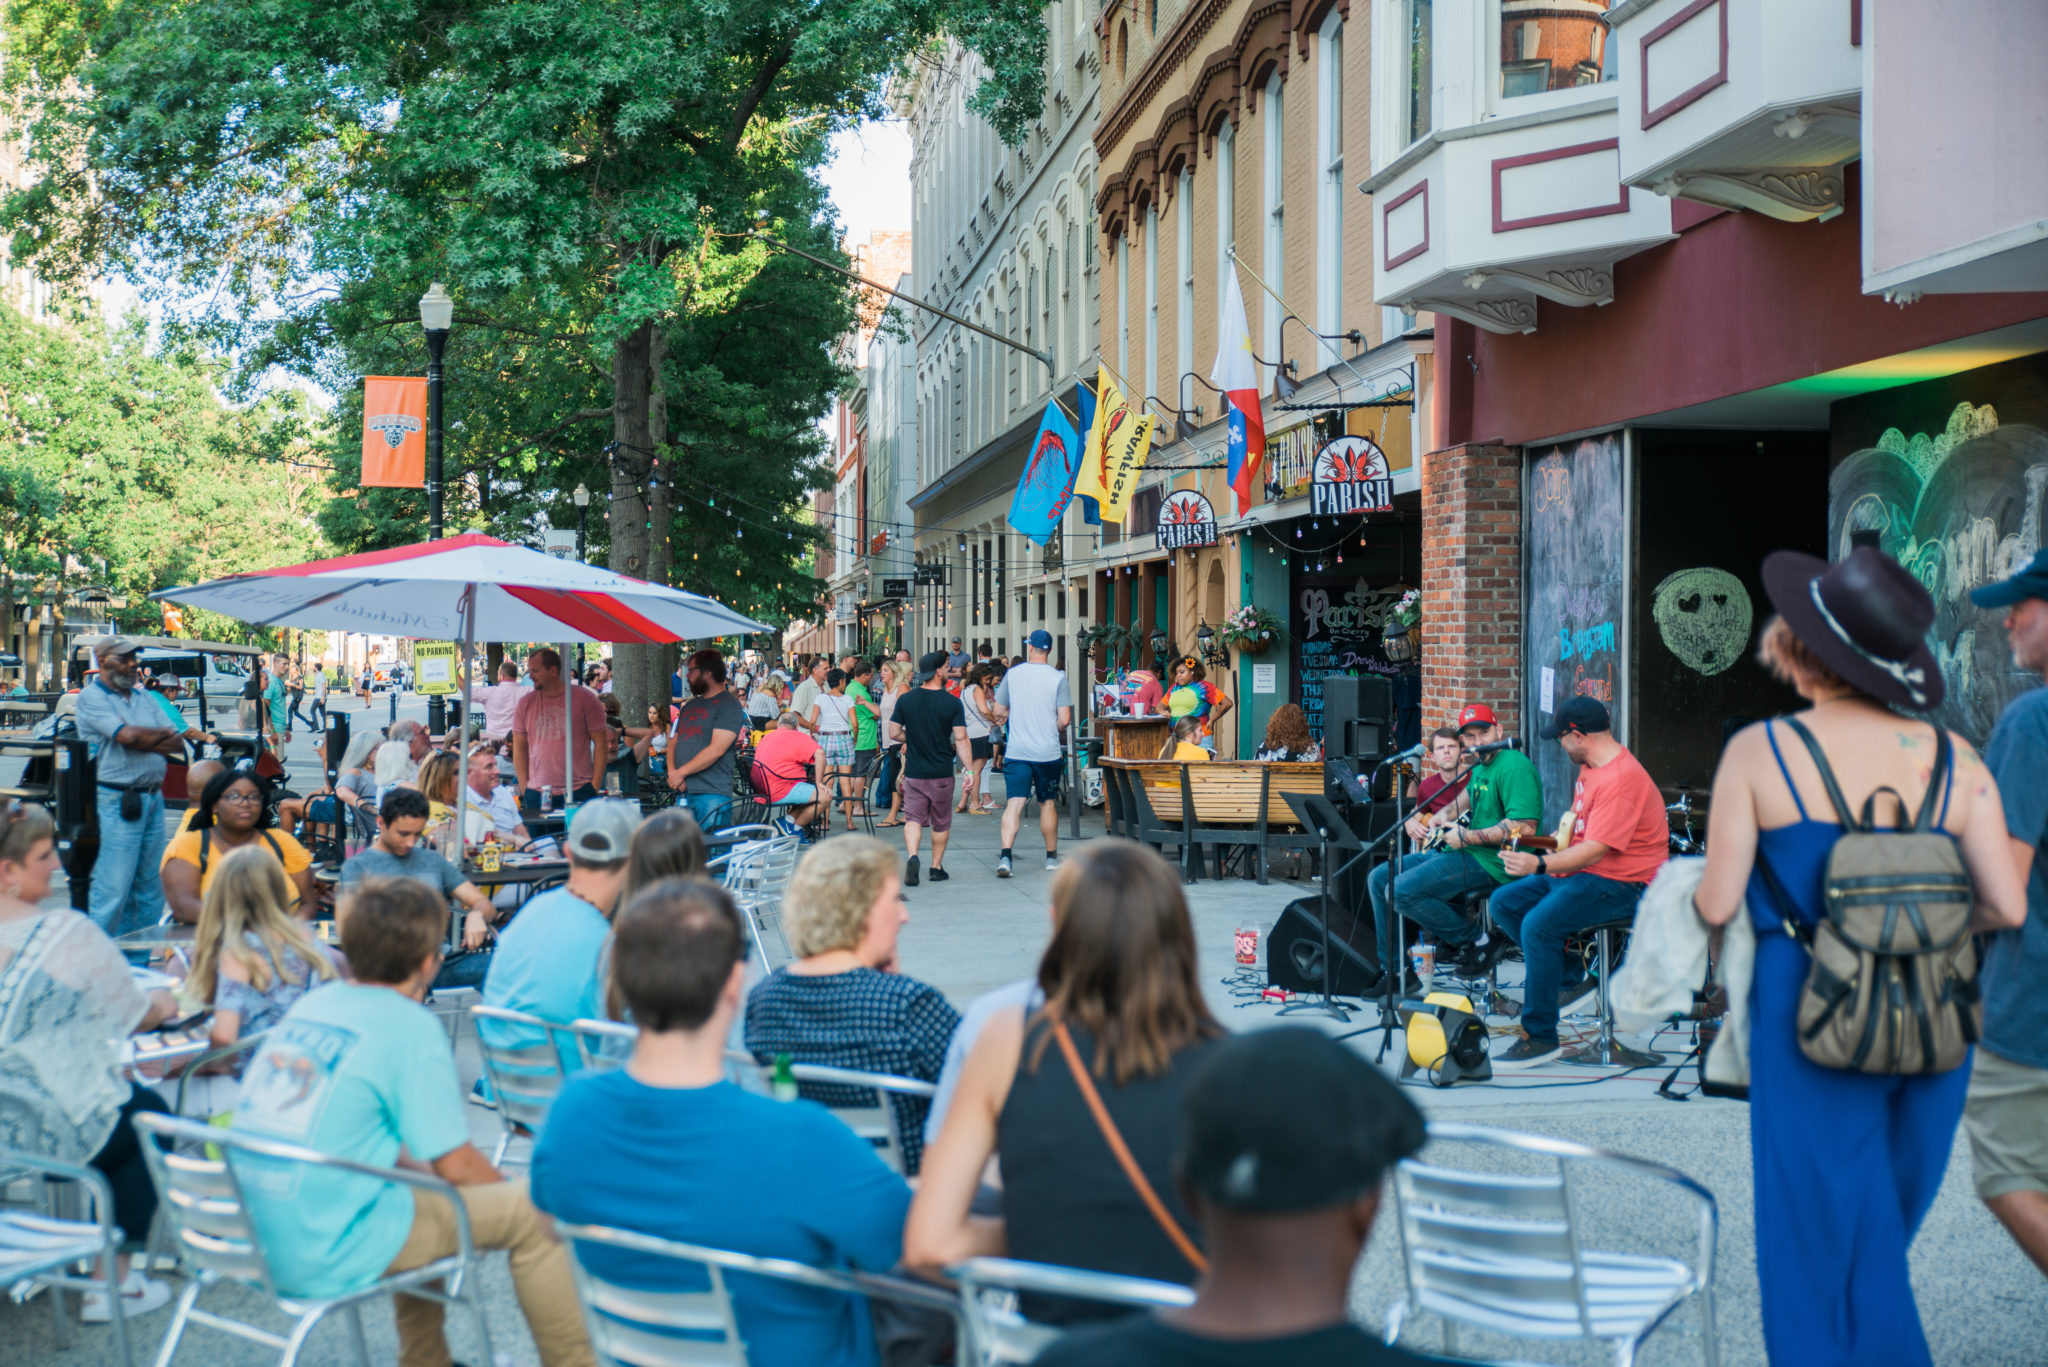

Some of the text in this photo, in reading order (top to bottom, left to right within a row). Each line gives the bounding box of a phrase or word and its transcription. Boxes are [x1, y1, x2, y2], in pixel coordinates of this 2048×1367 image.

[1312, 480, 1390, 515] PARISH
[1157, 523, 1215, 548] PARISH
[417, 646, 453, 656] NO PARKING
